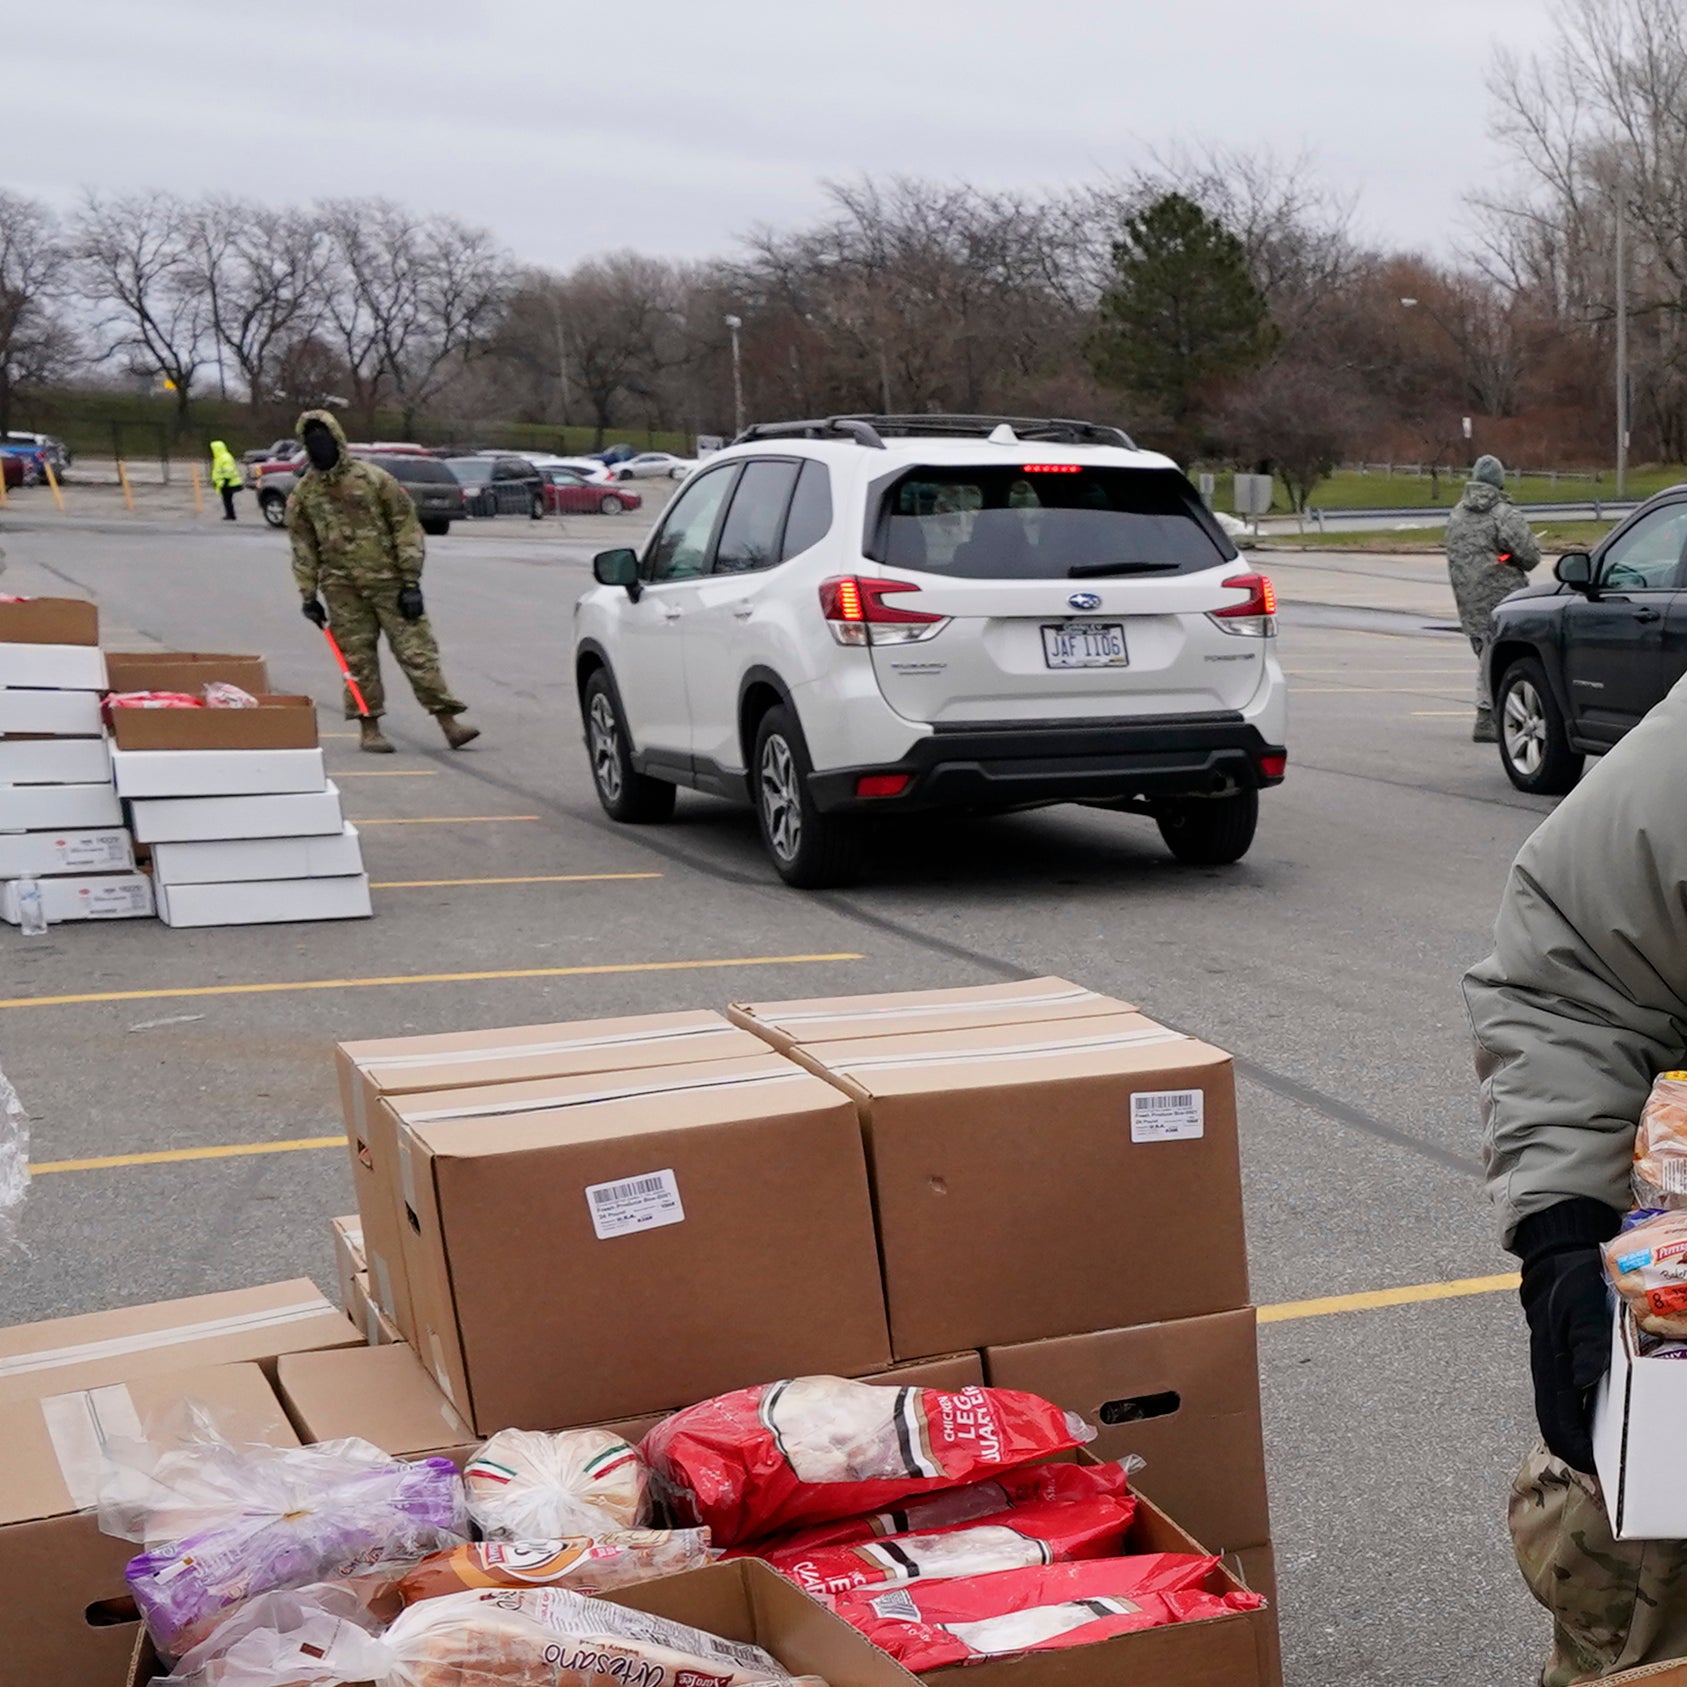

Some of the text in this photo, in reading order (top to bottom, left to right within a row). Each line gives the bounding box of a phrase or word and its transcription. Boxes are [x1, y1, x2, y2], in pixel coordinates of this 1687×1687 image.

[1051, 634, 1120, 656] JAF 1106
[1653, 1293, 1664, 1310] 8
[954, 1395, 975, 1439] LEG
